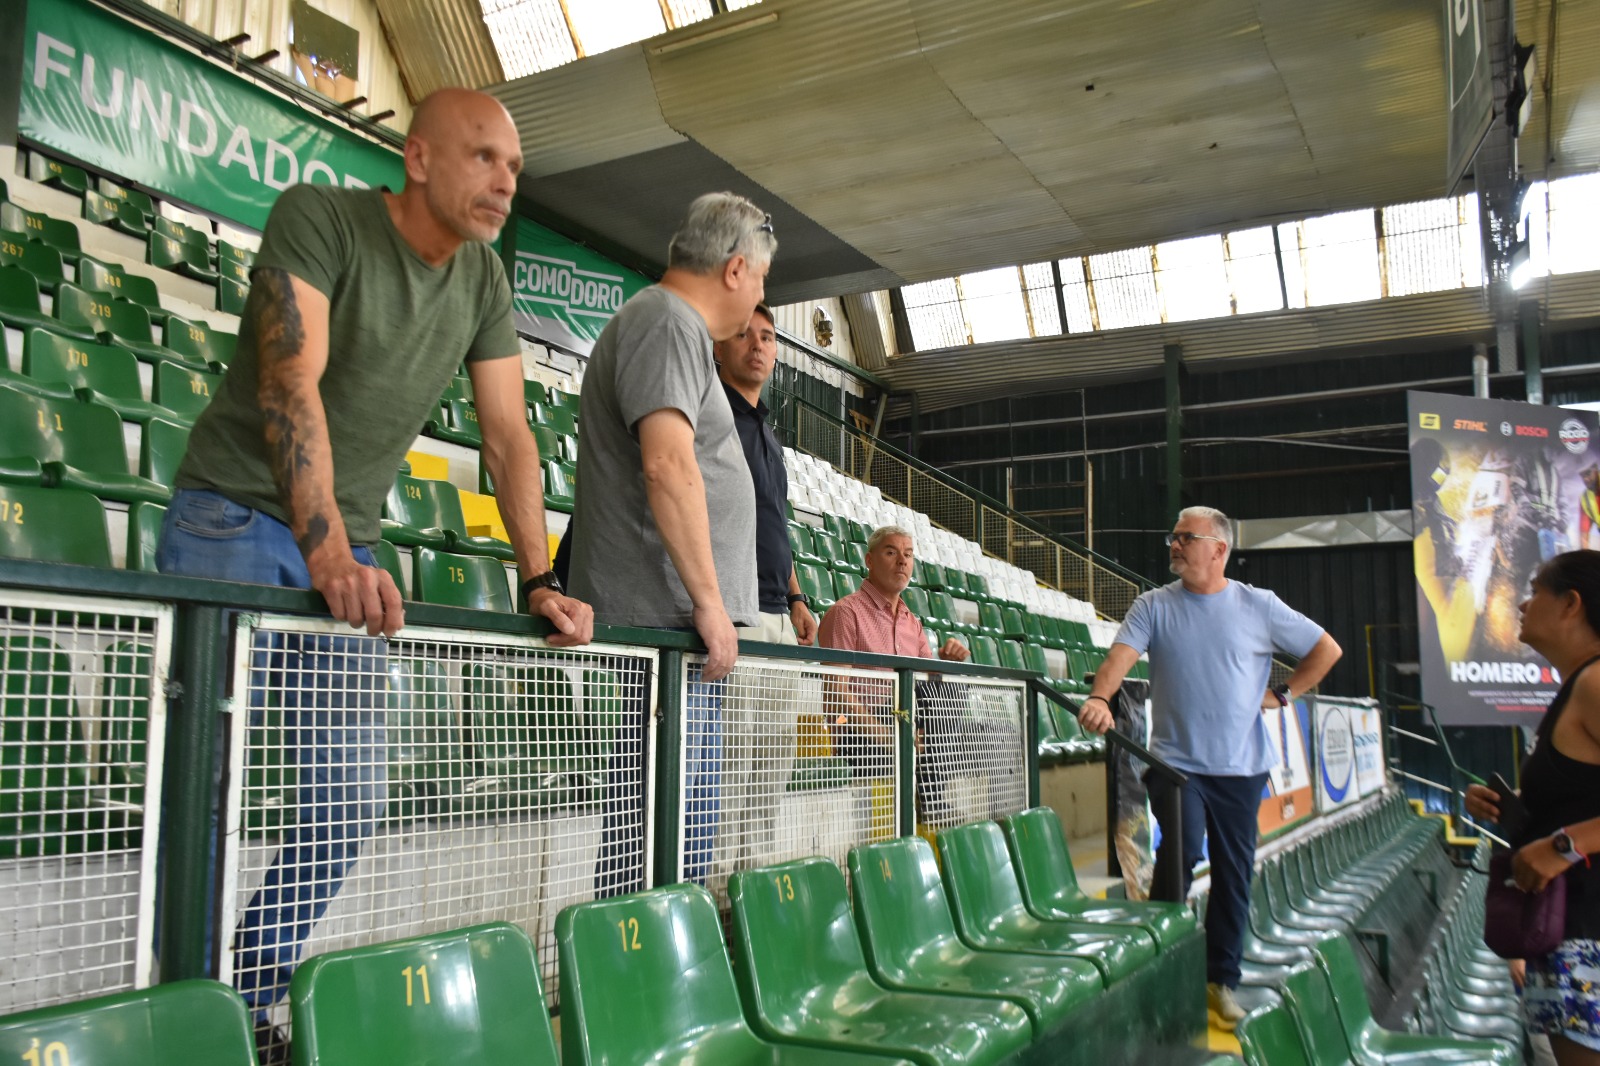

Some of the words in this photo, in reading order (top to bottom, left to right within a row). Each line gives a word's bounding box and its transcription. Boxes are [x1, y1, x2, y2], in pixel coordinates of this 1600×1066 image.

[33, 32, 372, 190] FUNDADO
[1, 240, 24, 258] 267
[514, 260, 624, 312] COMODORO
[90, 301, 111, 318] 219
[189, 327, 205, 343] 220
[68, 348, 88, 367] 170
[190, 380, 209, 397] 171
[1453, 419, 1487, 432] STIHL
[1515, 425, 1548, 438] BOSCH
[563, 473, 576, 486] 174
[404, 484, 421, 500] 124
[0, 499, 24, 524] 72
[448, 566, 465, 584] 75
[879, 858, 892, 882] 14
[775, 874, 795, 903] 13
[618, 917, 642, 952] 12
[402, 965, 431, 1007] 11
